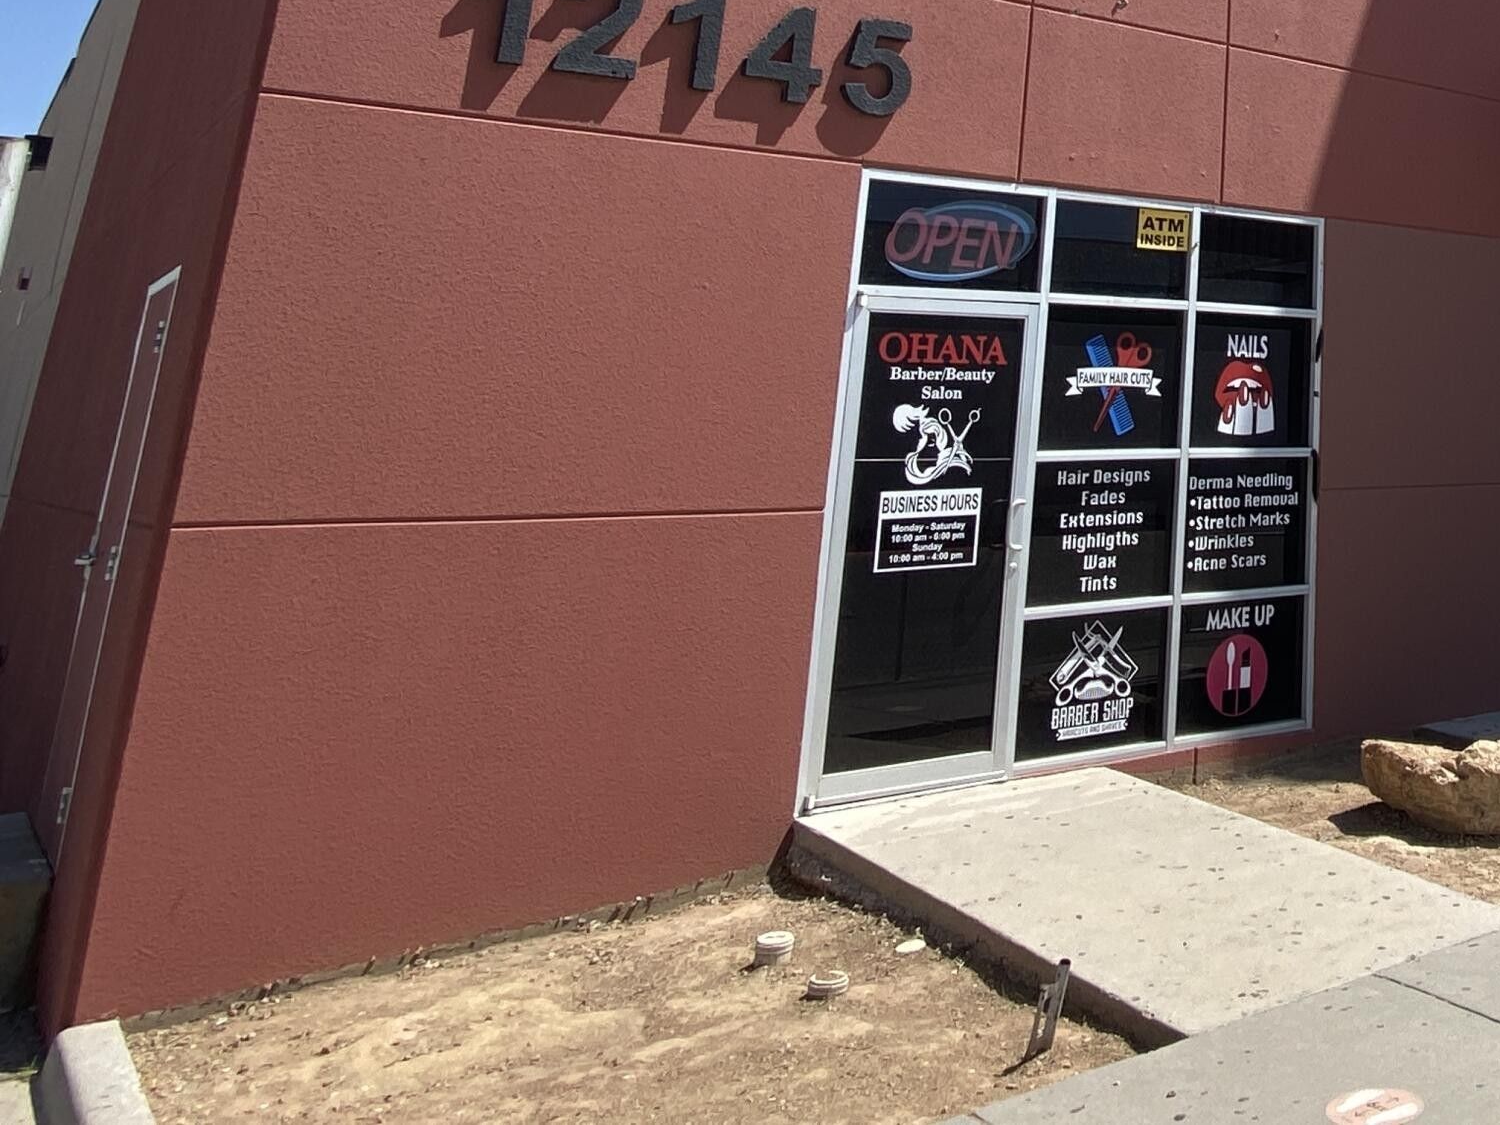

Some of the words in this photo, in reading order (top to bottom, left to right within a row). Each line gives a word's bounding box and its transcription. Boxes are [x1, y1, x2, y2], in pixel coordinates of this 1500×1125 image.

[1142, 216, 1184, 233] ATM
[885, 207, 1018, 269] OPEN
[1140, 234, 1184, 247] INSIDE
[878, 331, 1008, 365] OHANA
[1227, 333, 1268, 359] NAILS
[889, 366, 996, 384] Barber/Beauty
[1079, 371, 1107, 384] FAMILY
[1109, 372, 1129, 384] HAIR
[1130, 372, 1151, 385] CUTS
[921, 385, 962, 400] Salon
[1057, 470, 1090, 486] Hair
[1093, 468, 1151, 487] Designs
[1189, 476, 1233, 490] Derma
[1236, 473, 1293, 490] Needling
[881, 495, 938, 514] BUSINESS
[940, 493, 979, 511] HOURS
[1081, 490, 1126, 506] Fades
[1244, 491, 1299, 508] Removal
[891, 523, 924, 533] Monday
[930, 521, 966, 531] Saturday
[1060, 510, 1144, 529] Extensions
[1249, 512, 1290, 527] Marks
[891, 533, 913, 543] 10:00
[914, 534, 927, 542] am
[951, 532, 965, 542] pm
[1062, 531, 1139, 553] Highligths
[912, 543, 943, 552] Sunday
[888, 554, 911, 563] 10:00
[912, 554, 925, 562] am
[950, 552, 963, 561] pm
[1083, 555, 1117, 570] Wax
[1231, 554, 1267, 569] Scars
[1079, 575, 1117, 592] Tints
[1206, 606, 1250, 631] MAKE
[1254, 604, 1275, 626] UP
[1051, 702, 1099, 730] BARBER
[1102, 697, 1134, 721] SHOP
